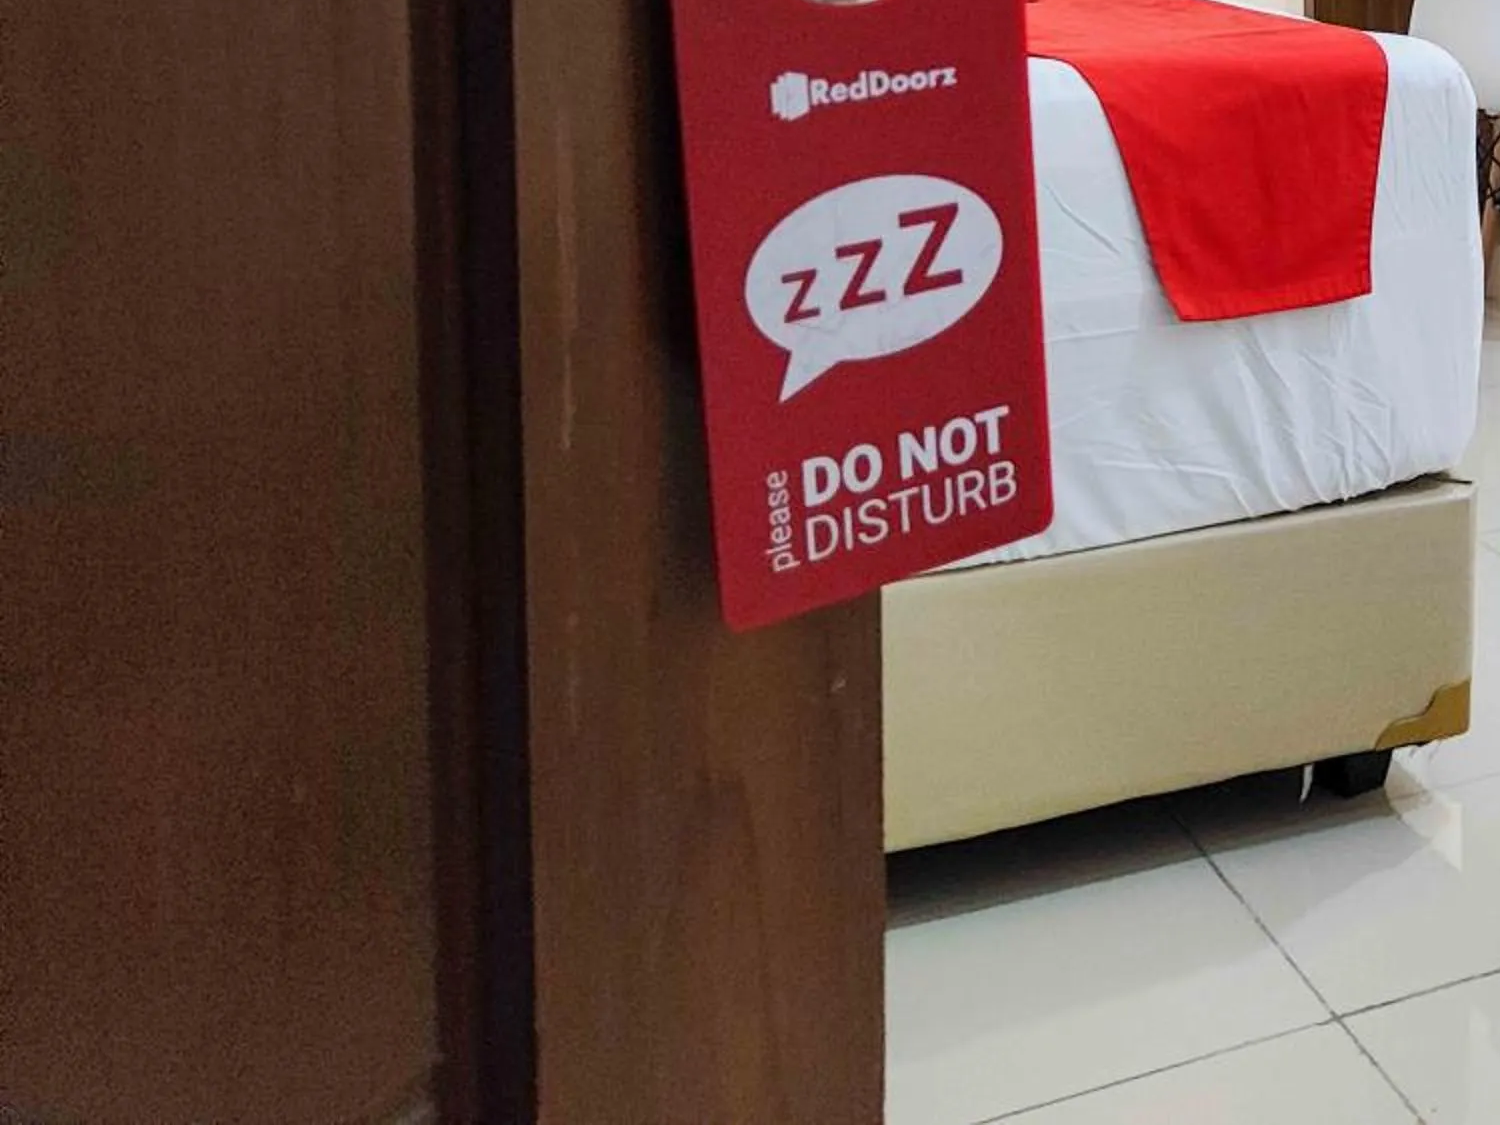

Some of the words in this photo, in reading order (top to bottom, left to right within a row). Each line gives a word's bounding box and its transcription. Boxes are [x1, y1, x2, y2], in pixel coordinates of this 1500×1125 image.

[810, 67, 957, 106] RedDoorz
[802, 443, 883, 507] DO
[898, 405, 1010, 479] NOT
[765, 470, 800, 573] please
[805, 460, 1017, 562] DISTURB
